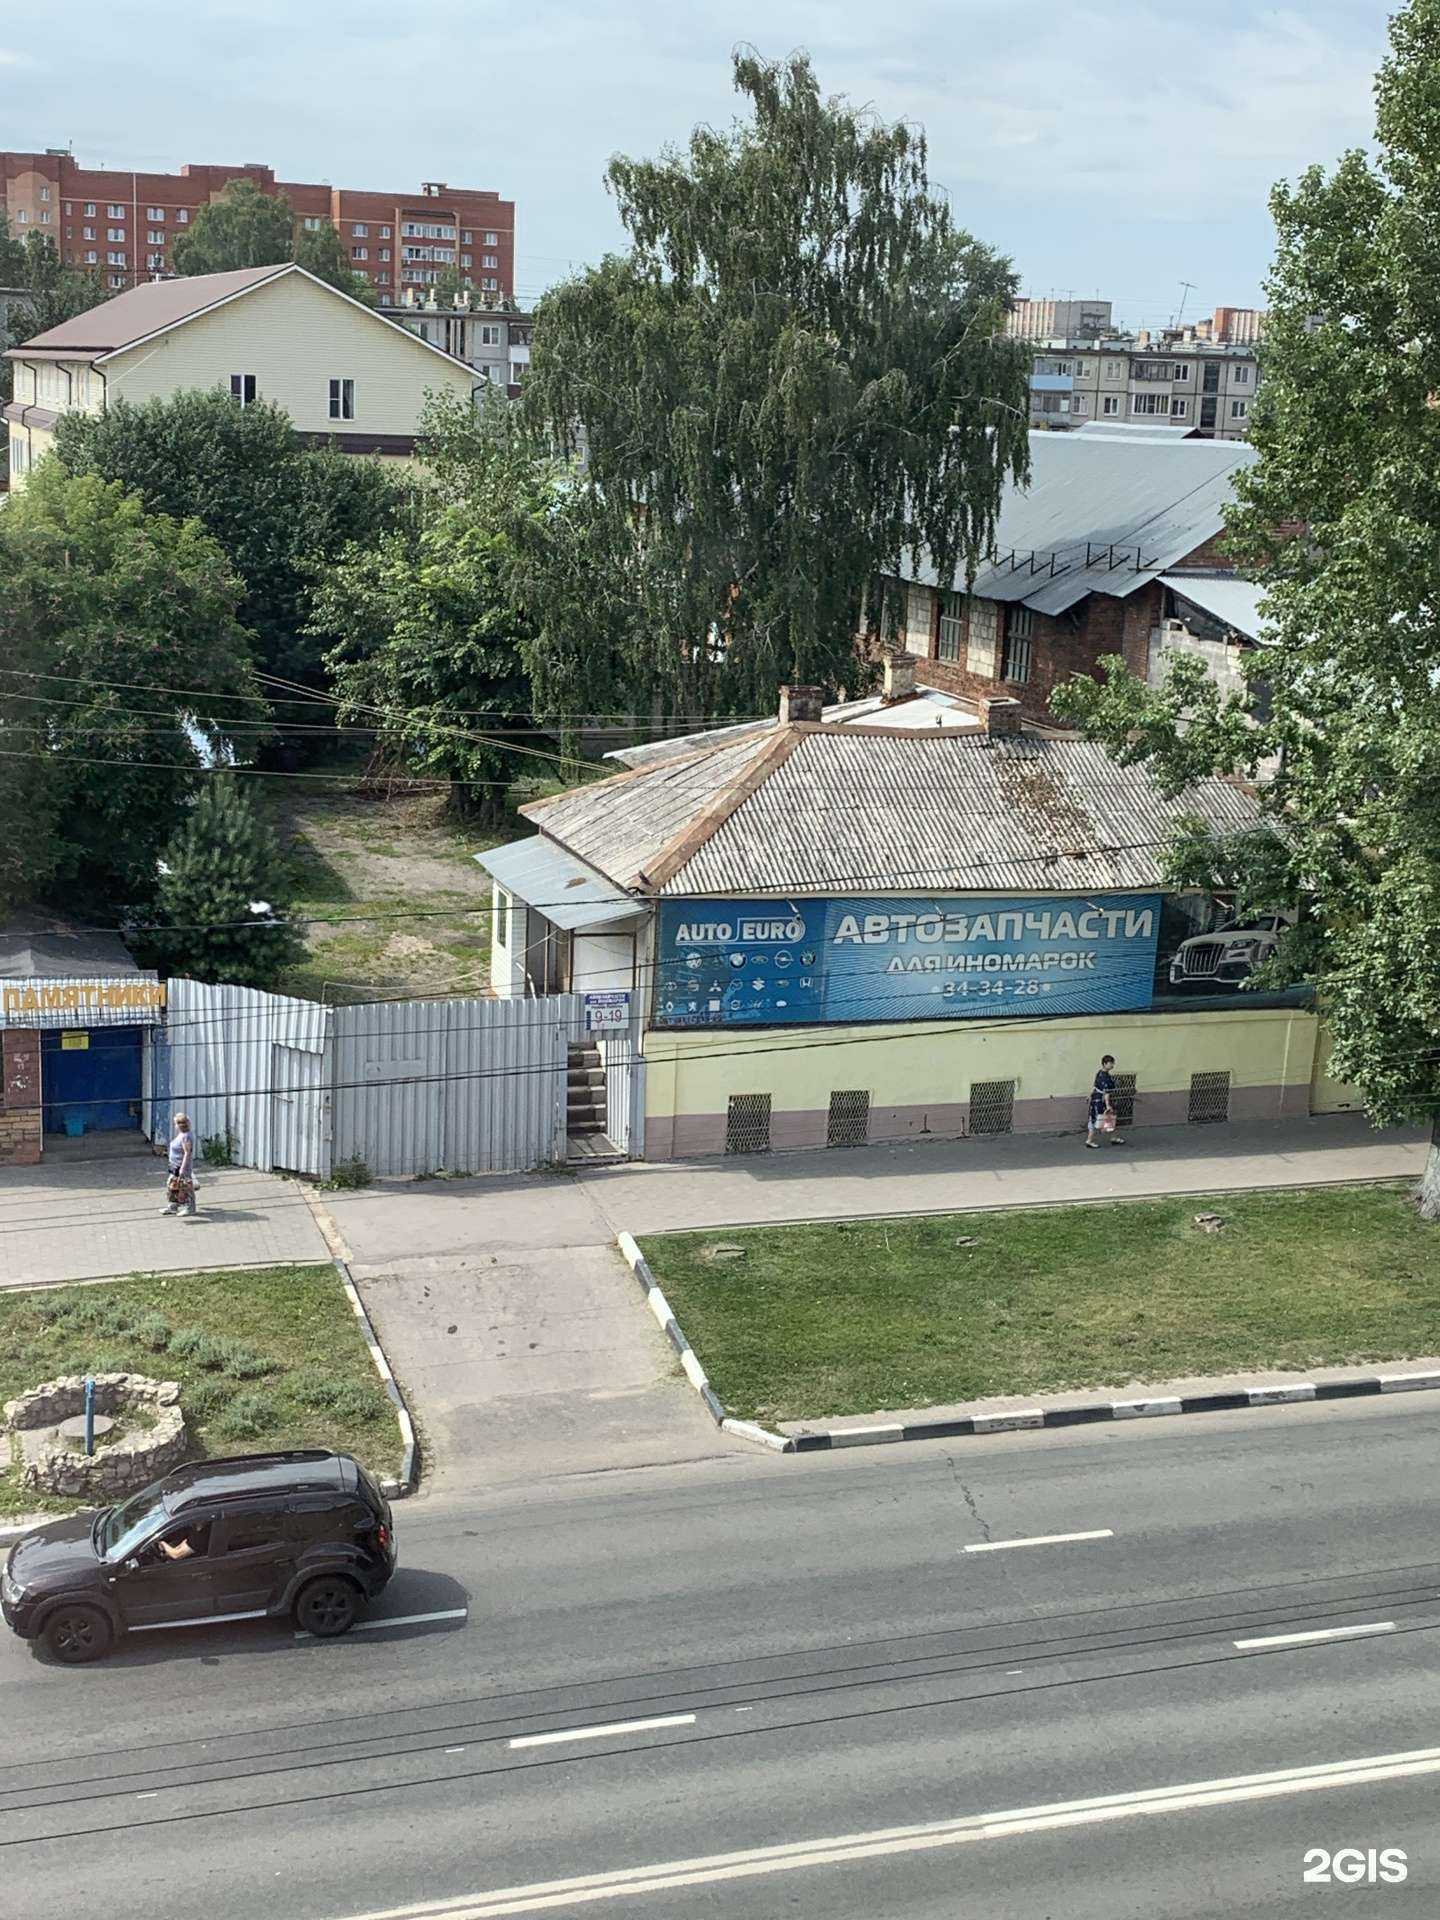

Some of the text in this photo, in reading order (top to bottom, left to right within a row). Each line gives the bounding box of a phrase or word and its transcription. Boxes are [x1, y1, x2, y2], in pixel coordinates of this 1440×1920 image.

[676, 922, 801, 941] AUTO EURO
[832, 909, 1153, 944] АВТОЗАПЧАСТИ
[886, 951, 1096, 974] ДЛЯ ИНОМАРОК
[3, 983, 167, 1011] ПАМЯТНИКИ
